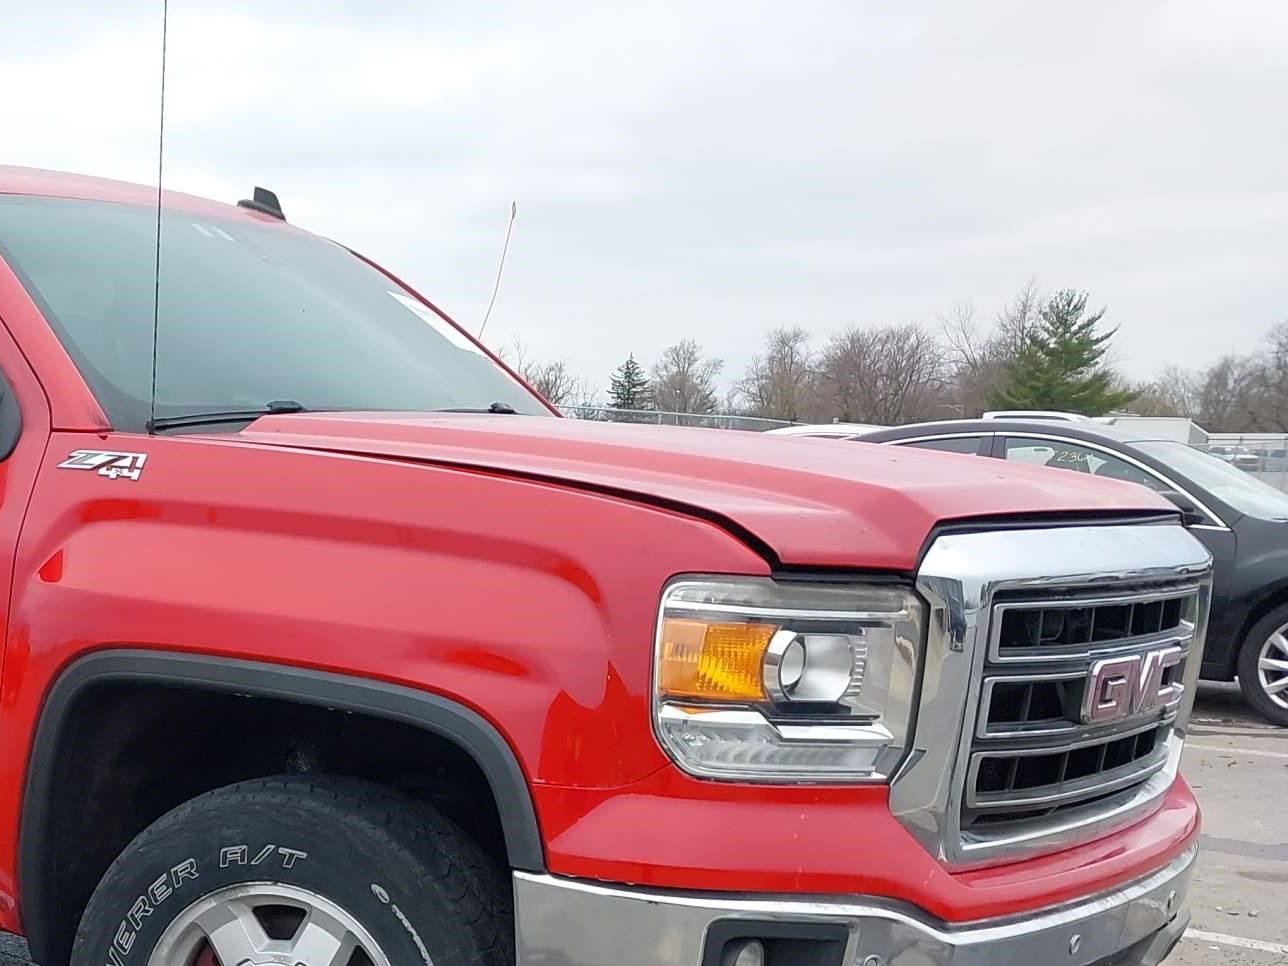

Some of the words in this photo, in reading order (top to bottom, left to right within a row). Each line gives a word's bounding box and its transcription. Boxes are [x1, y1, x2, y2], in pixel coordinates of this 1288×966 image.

[56, 449, 148, 472] Z71
[1091, 646, 1183, 720] GMC
[219, 844, 308, 869] A/T
